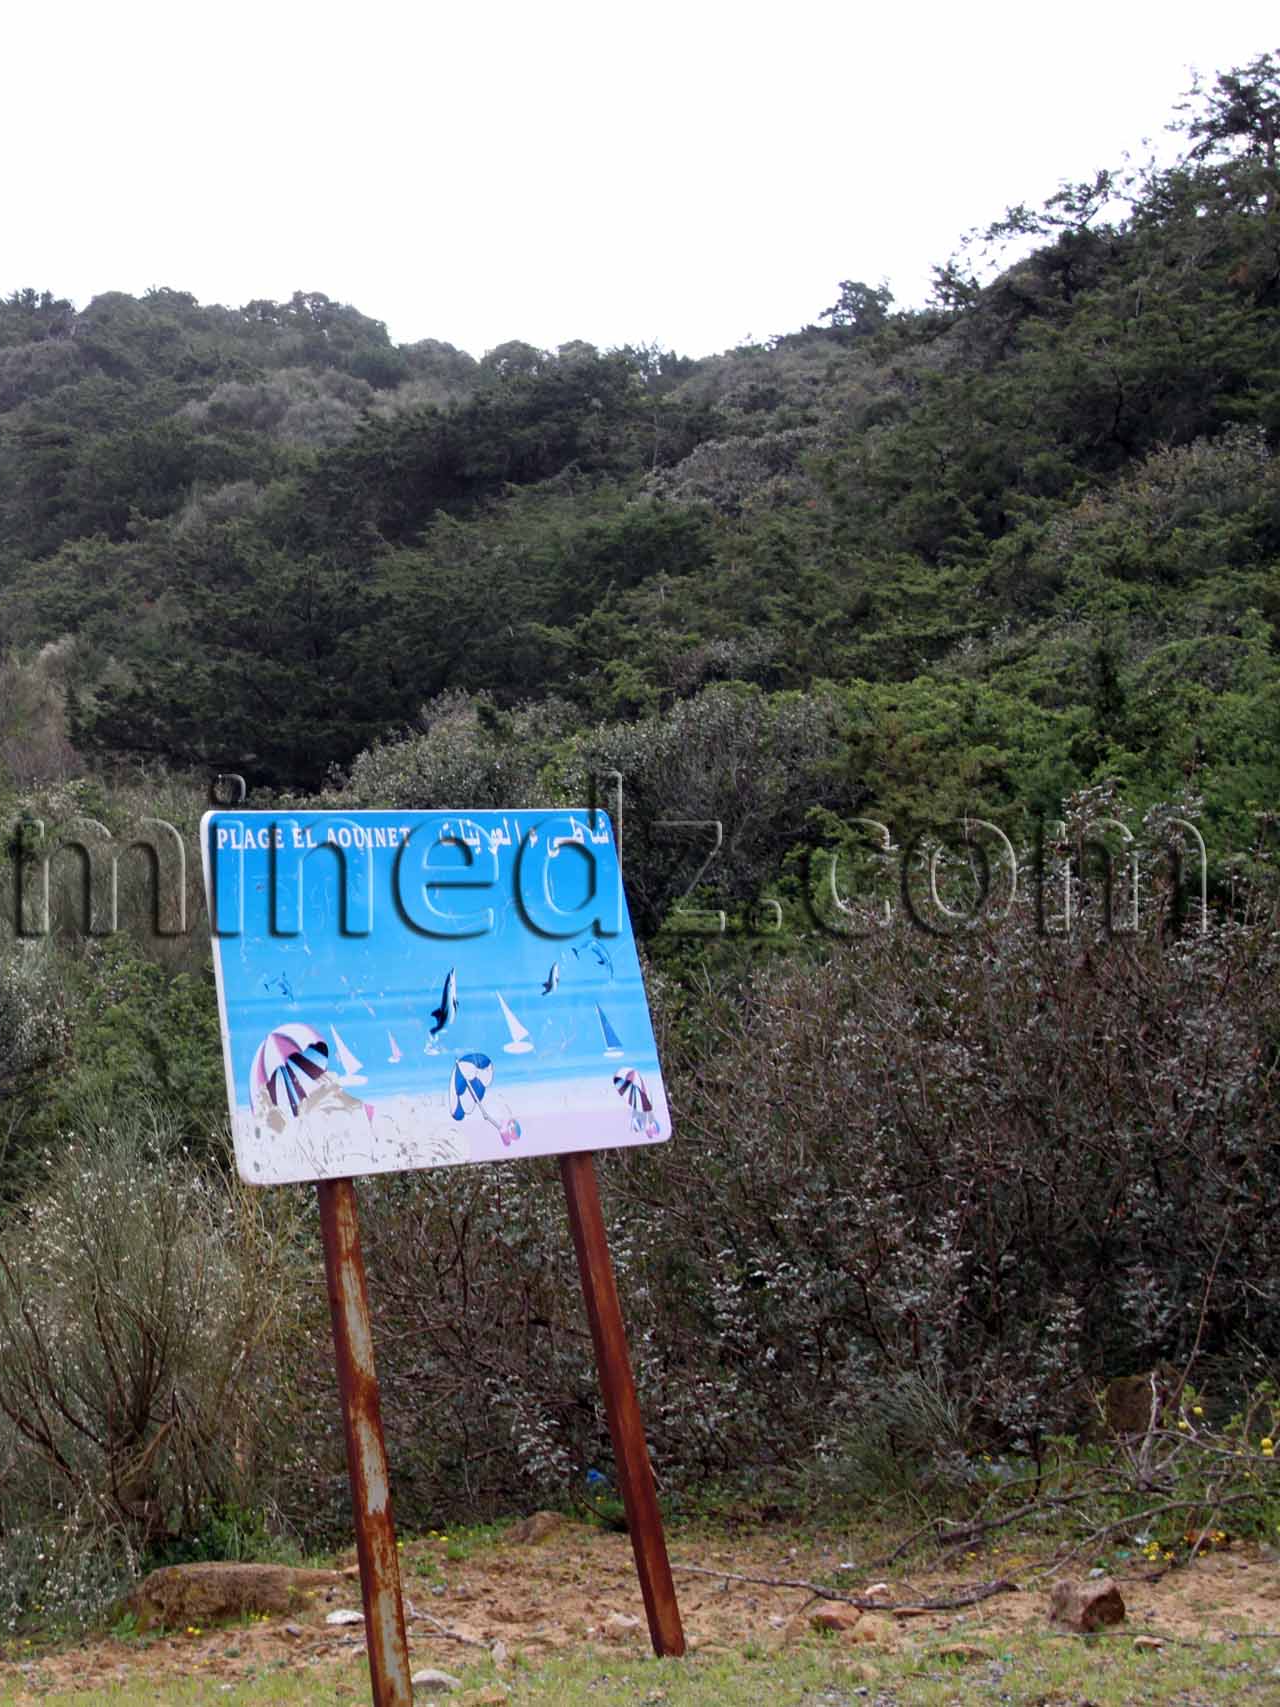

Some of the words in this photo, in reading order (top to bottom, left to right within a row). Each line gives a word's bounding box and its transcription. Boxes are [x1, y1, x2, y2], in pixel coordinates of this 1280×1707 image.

[217, 828, 283, 850] PLAGE
[292, 827, 318, 849] EL
[327, 826, 411, 849] AOUINET
